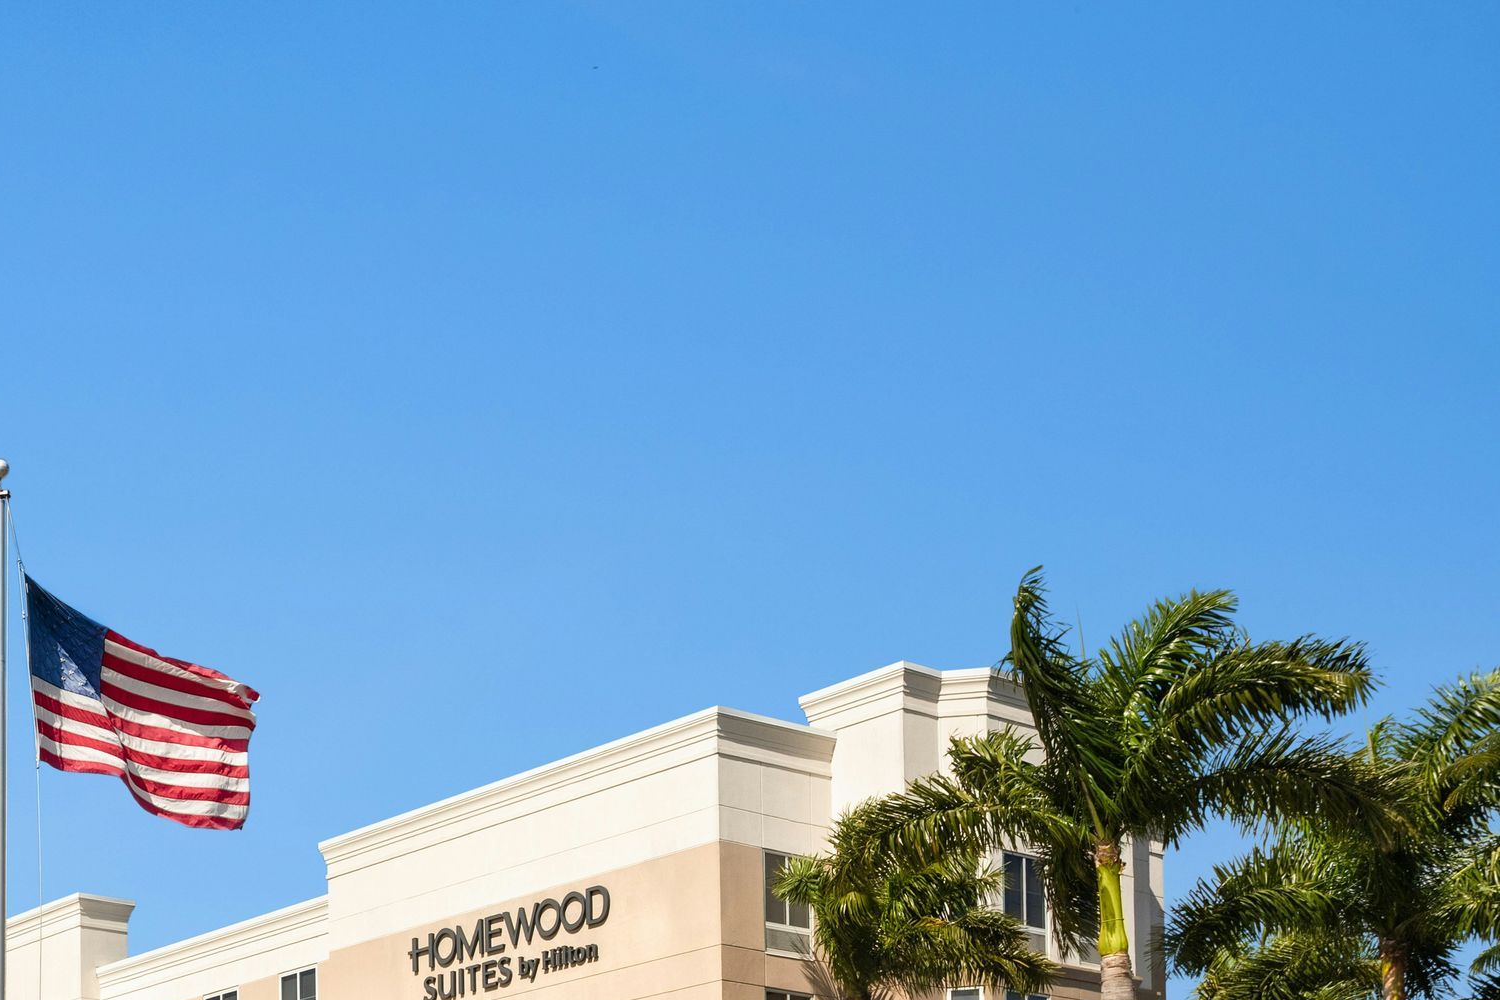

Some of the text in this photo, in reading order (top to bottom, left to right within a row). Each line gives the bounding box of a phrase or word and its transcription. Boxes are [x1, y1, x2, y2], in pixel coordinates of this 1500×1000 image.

[408, 885, 610, 975] HOMEWOOD
[518, 956, 539, 982] by
[542, 943, 598, 973] Hilton
